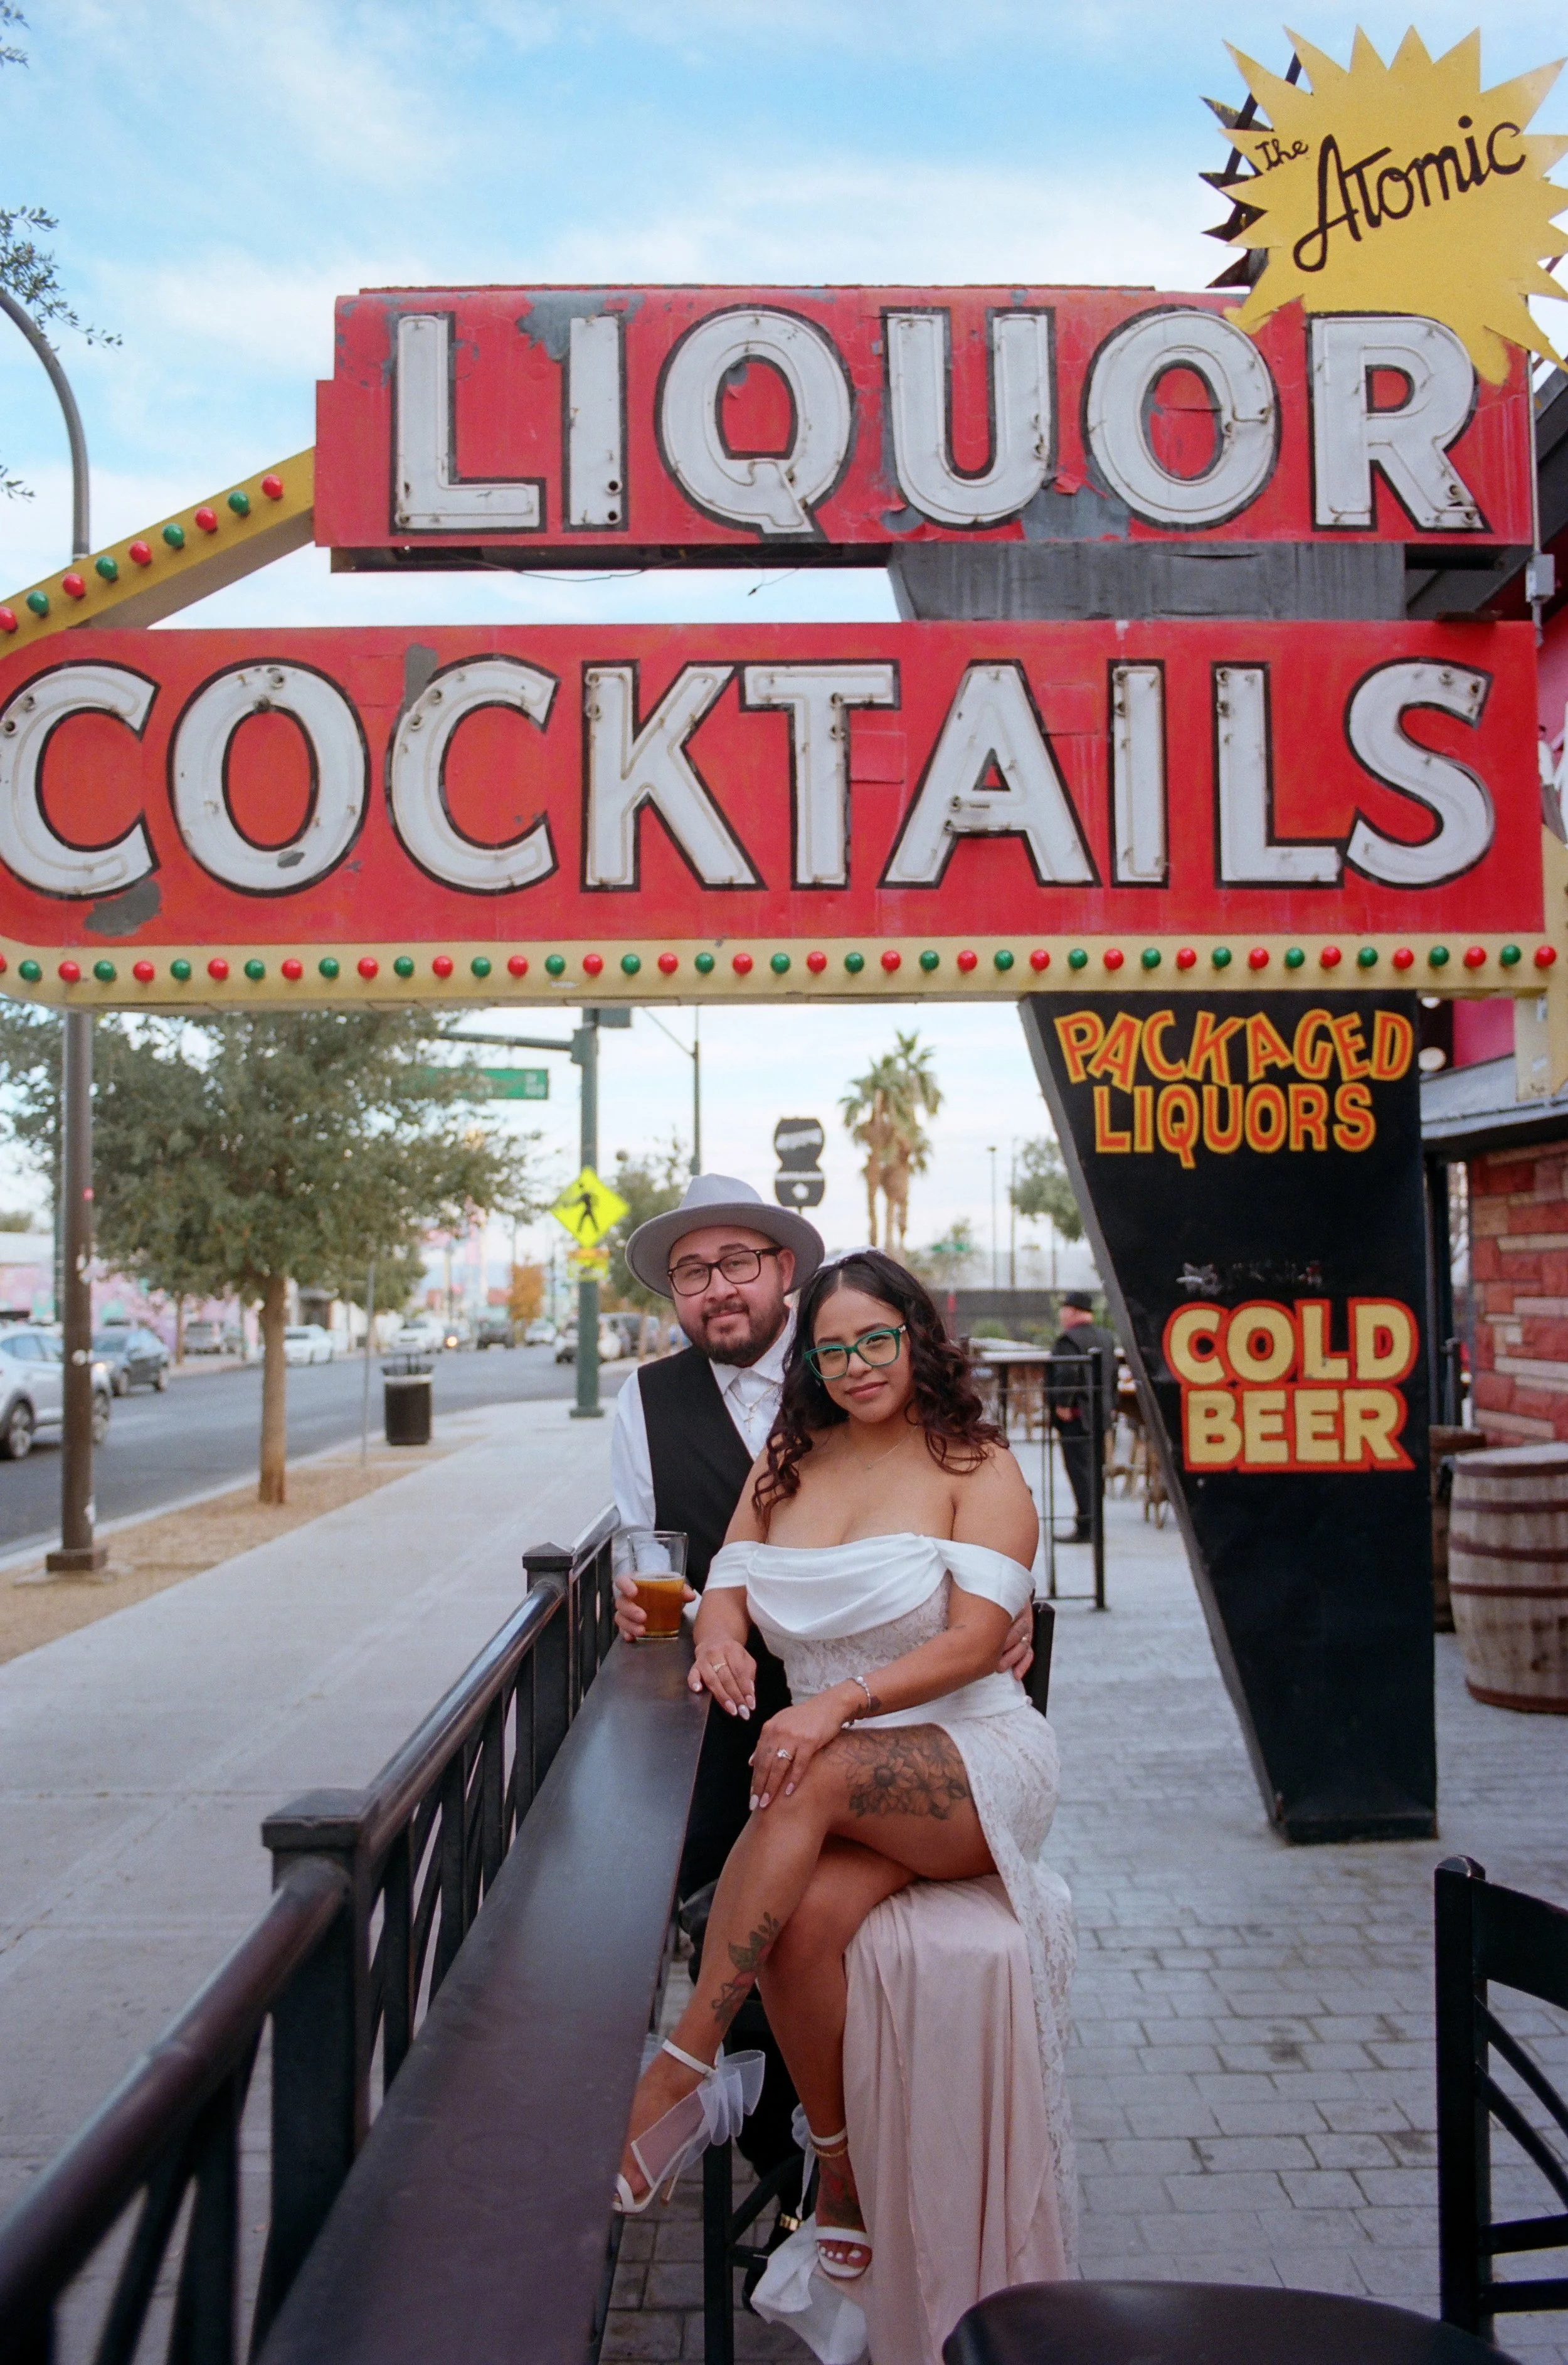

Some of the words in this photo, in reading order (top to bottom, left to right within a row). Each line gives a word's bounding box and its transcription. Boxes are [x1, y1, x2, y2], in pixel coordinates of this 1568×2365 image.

[1254, 138, 1309, 171] The
[1293, 115, 1527, 272] Atomic
[389, 304, 1492, 543] LIQUOR
[0, 656, 1495, 901] COCKTAILS
[1054, 1009, 1414, 1093] PACKAGED
[1093, 1082, 1377, 1169] LIQUORS
[1163, 1297, 1419, 1383] COLD
[1181, 1384, 1416, 1472] BEER
